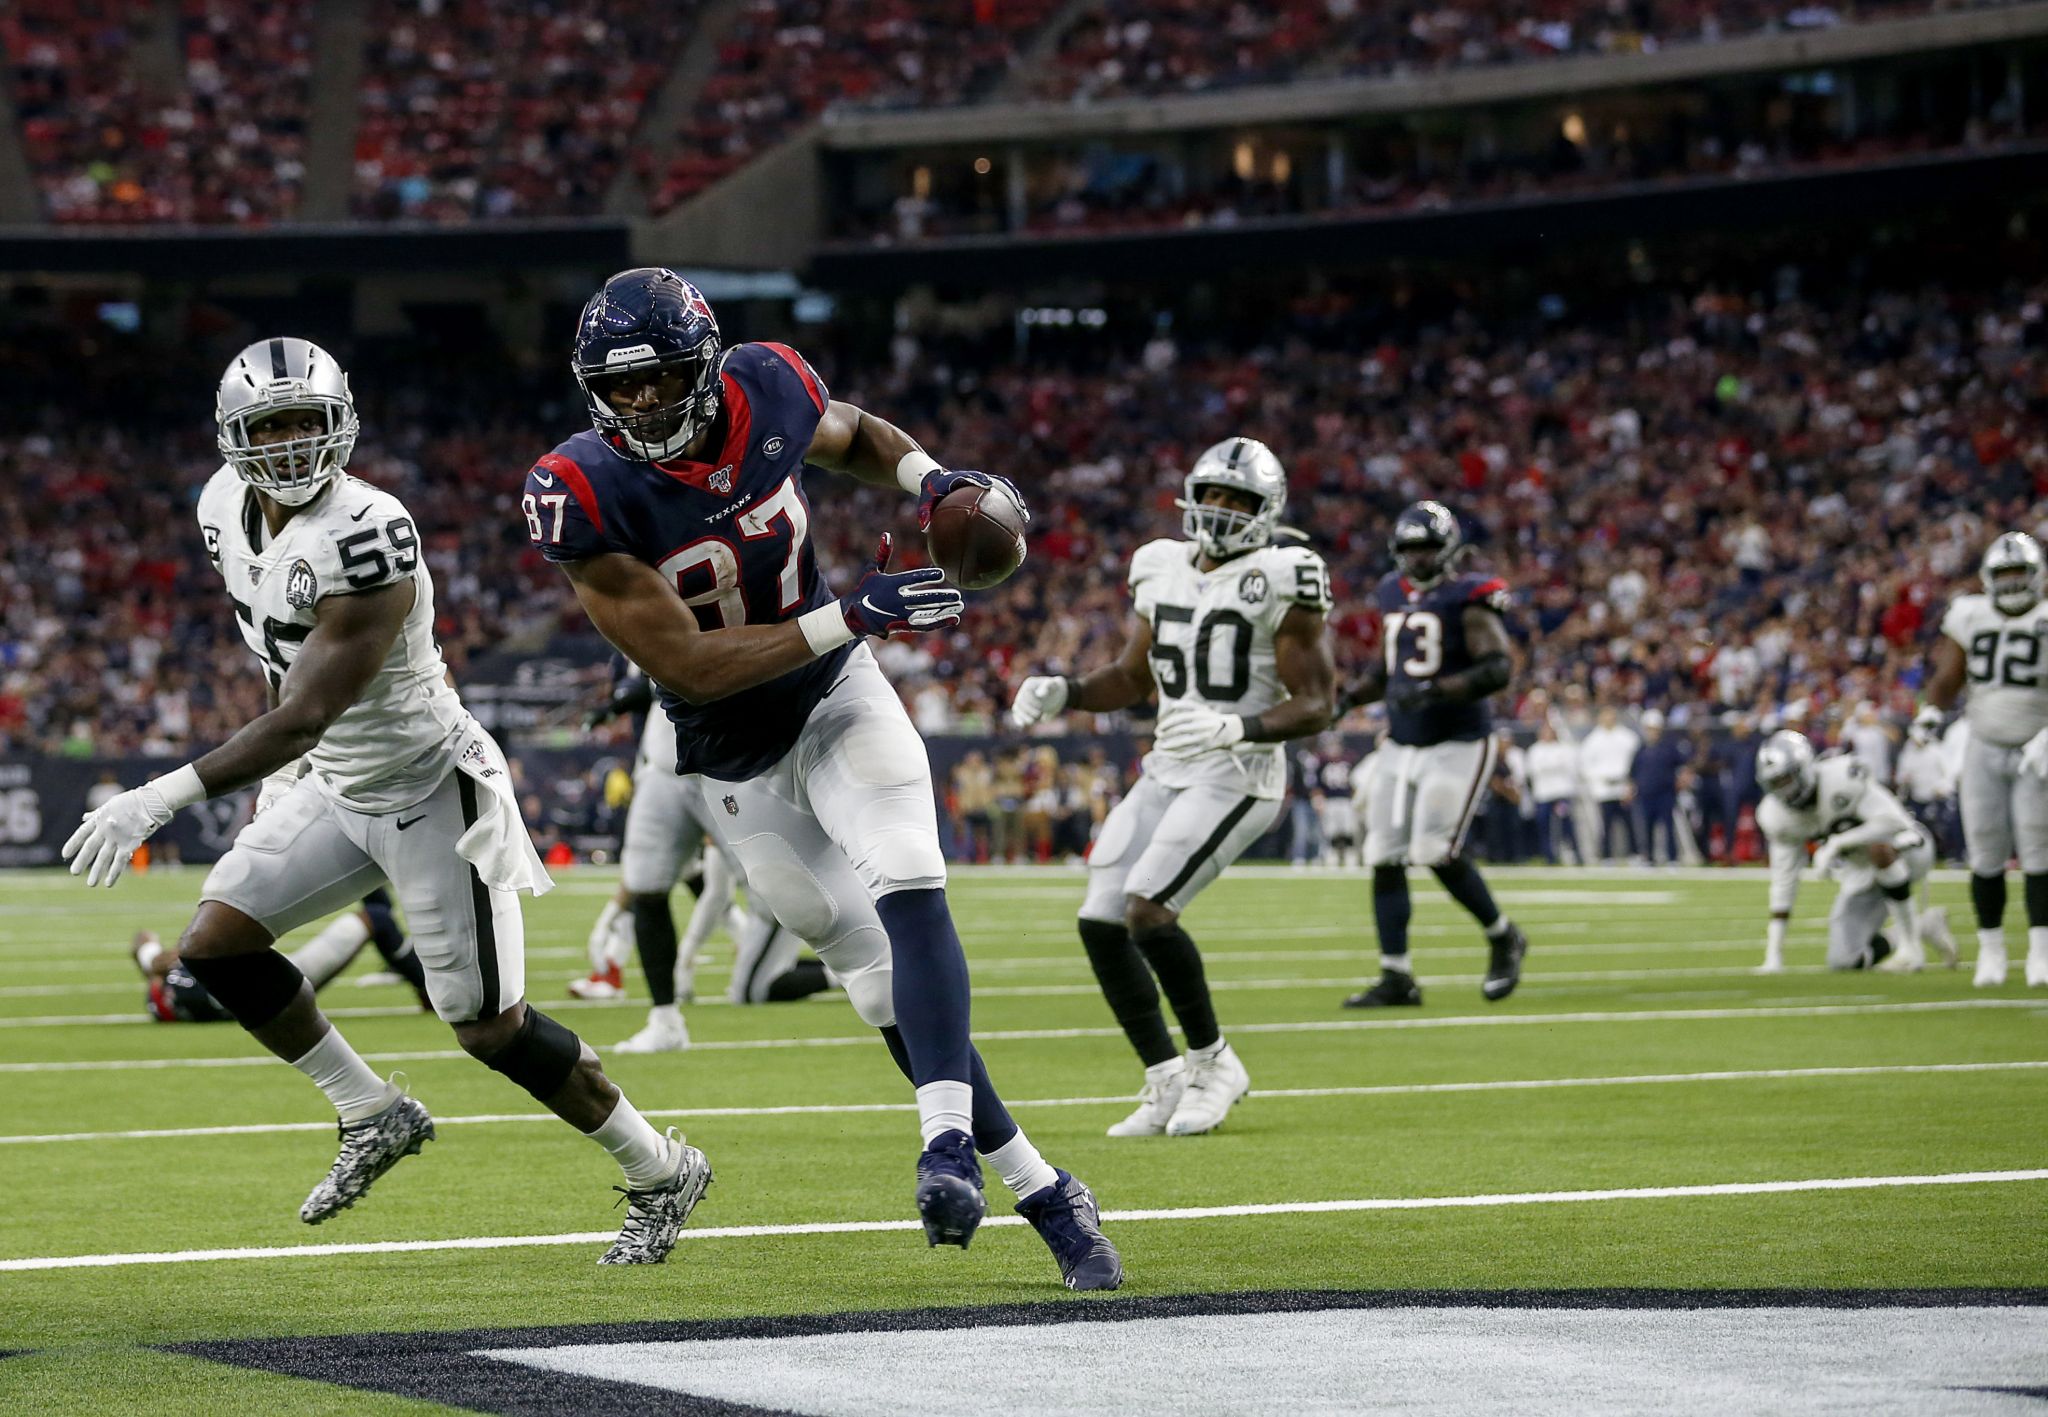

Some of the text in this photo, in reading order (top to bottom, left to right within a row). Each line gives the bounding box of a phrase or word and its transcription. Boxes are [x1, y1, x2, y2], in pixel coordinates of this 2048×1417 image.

[612, 348, 646, 357] TEXANS
[521, 492, 568, 544] 87
[704, 493, 752, 524] TEXANS
[336, 517, 418, 588] 59
[655, 473, 811, 632] 87
[1151, 603, 1254, 702] 50
[1968, 630, 2040, 688] 92
